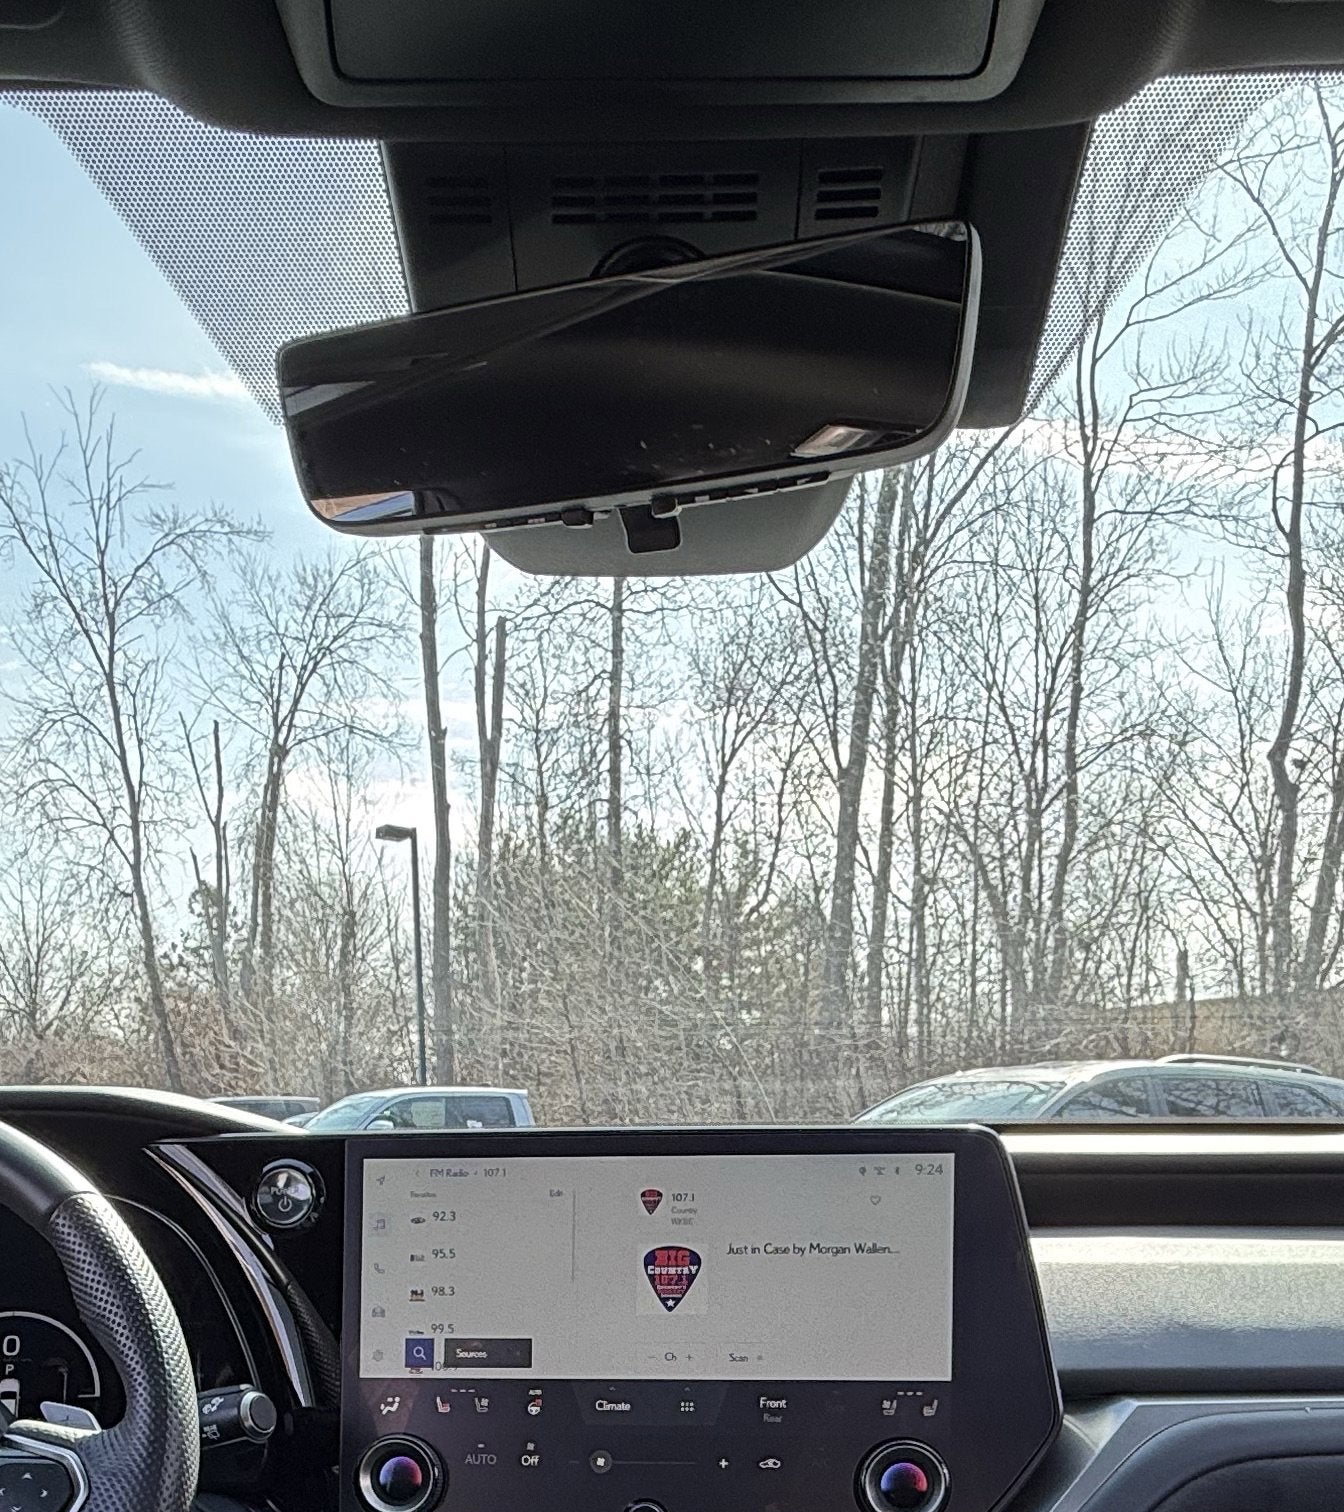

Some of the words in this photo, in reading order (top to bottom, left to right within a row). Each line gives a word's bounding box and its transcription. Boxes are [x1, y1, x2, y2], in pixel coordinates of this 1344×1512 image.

[429, 1168, 445, 1178] FM
[446, 1168, 469, 1178] Radio
[483, 1168, 506, 1178] 107.1
[915, 1164, 944, 1175] 9:24
[671, 1193, 695, 1202] 107.1
[432, 1211, 456, 1222] 92.3
[431, 1249, 456, 1259] 95.5
[726, 1243, 748, 1255] Just
[751, 1243, 761, 1254] in
[764, 1243, 790, 1255] Case
[792, 1243, 806, 1256] by
[809, 1243, 851, 1256] Morgan
[654, 1250, 690, 1266] BIG
[431, 1286, 455, 1296] 98.3
[430, 1323, 455, 1334] 99.5
[2, 1335, 21, 1356] 0
[455, 1348, 488, 1359] Sources
[729, 1352, 749, 1362] Scan
[5, 1364, 15, 1375] P
[595, 1400, 632, 1411] Climate
[759, 1397, 788, 1409] Front
[464, 1454, 497, 1465] AUTO
[521, 1455, 540, 1466] Off
